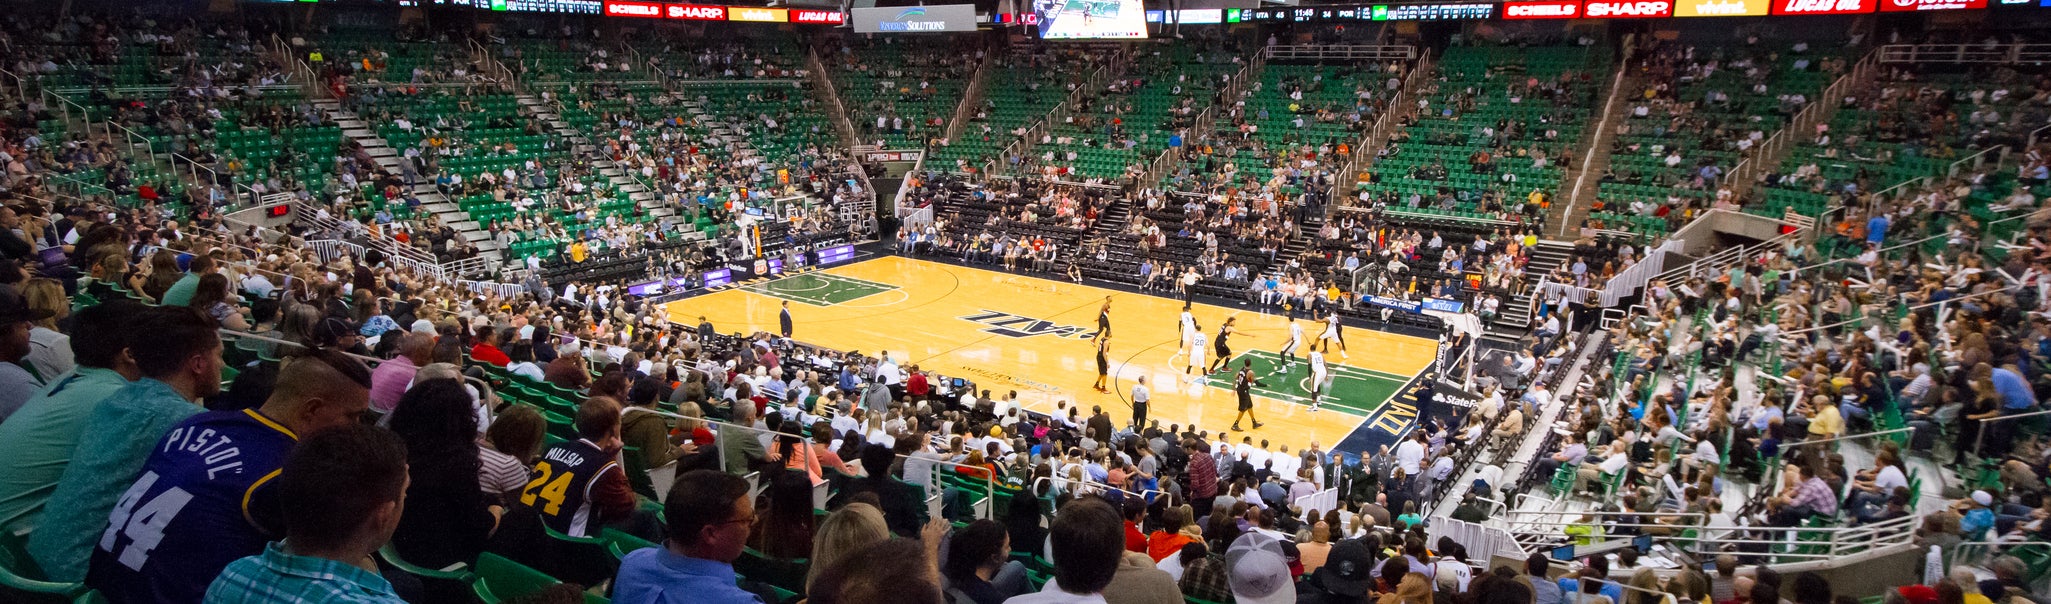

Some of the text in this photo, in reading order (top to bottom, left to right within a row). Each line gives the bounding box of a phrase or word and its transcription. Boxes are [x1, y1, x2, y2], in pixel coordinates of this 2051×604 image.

[609, 4, 659, 15] SCHEELS
[1507, 4, 1576, 16] SCHEELS
[1784, 0, 1861, 12] LUCAS OIL
[799, 12, 841, 21] LUCAS OIL
[1339, 10, 1354, 18] POR
[1370, 297, 1417, 312] AMERICA FIRST
[1194, 338, 1205, 347] 20
[544, 447, 584, 468] MILLSAP
[519, 460, 575, 517] 24
[100, 469, 195, 573] 44
